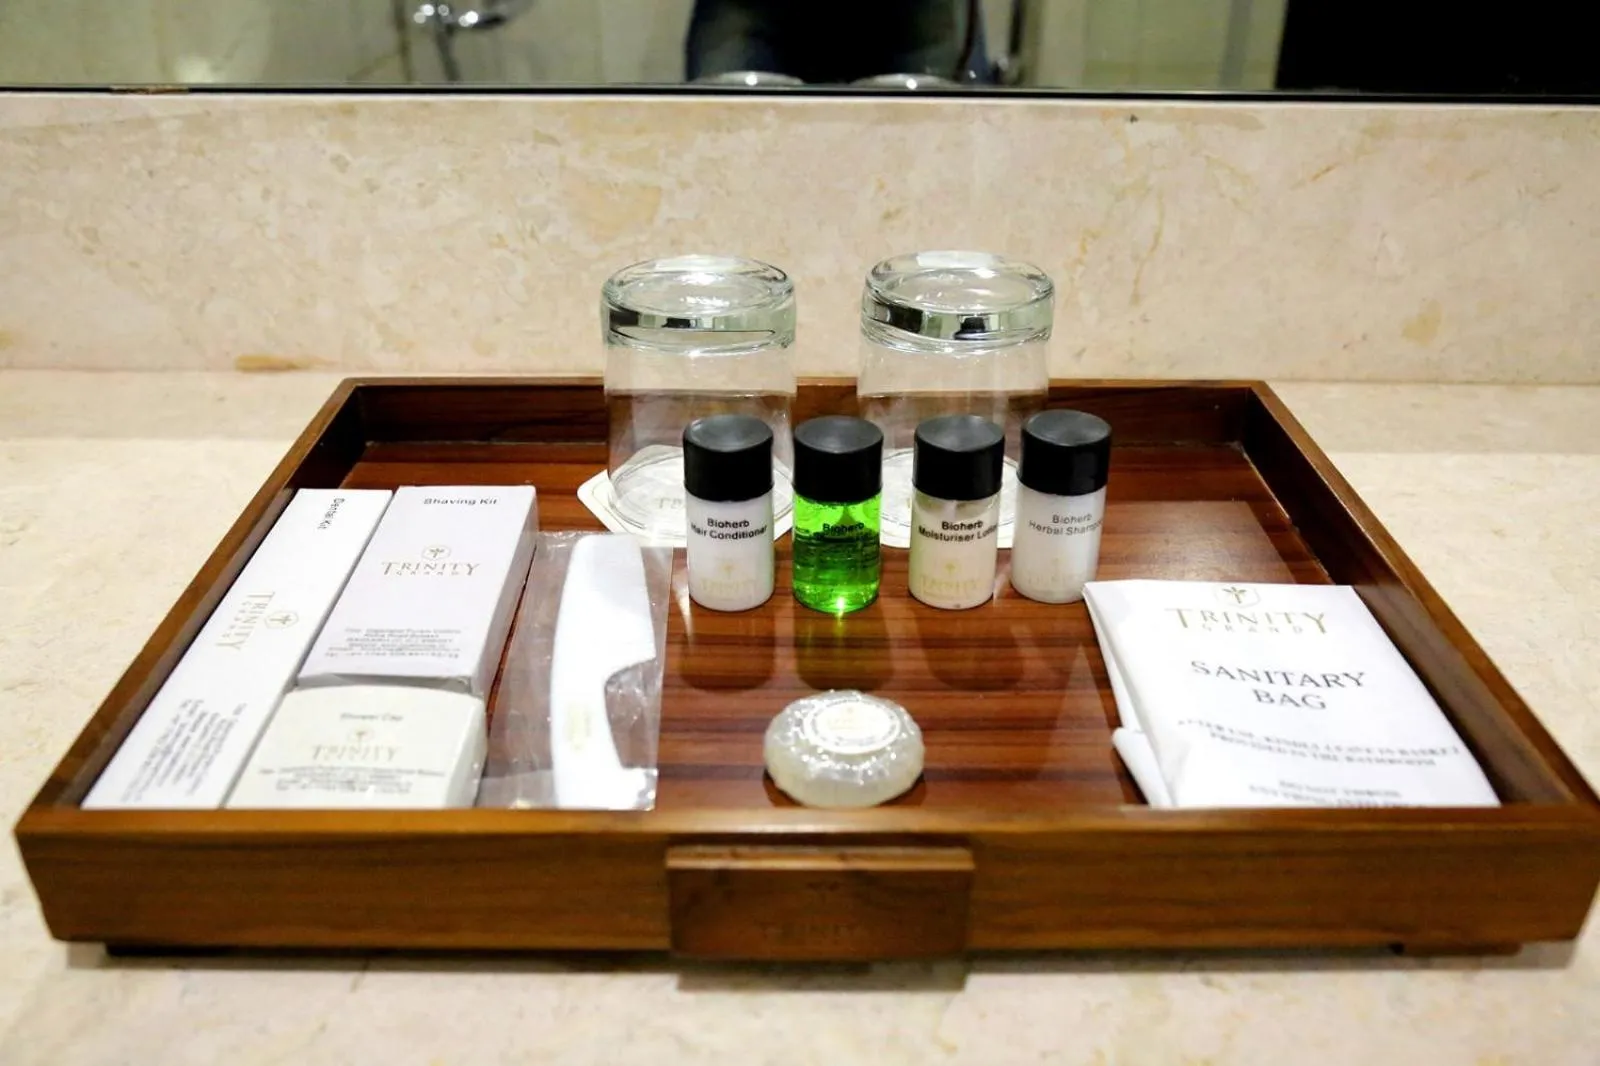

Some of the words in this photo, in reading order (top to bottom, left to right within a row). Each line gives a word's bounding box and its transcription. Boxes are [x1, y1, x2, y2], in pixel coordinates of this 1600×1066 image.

[423, 498, 476, 506] Shaving
[707, 518, 750, 529] Bioherb
[941, 520, 984, 531] Bioherb
[1052, 513, 1093, 524] Bioherb
[709, 525, 768, 540] Conditioner
[918, 525, 975, 542] Moisturiser
[1028, 520, 1063, 535] Herbal
[382, 561, 480, 576] TRINITY
[215, 591, 276, 650] TRINITY
[1165, 607, 1329, 634] TRINITY
[1190, 660, 1366, 688] SANITARY
[1253, 688, 1327, 710] BAG
